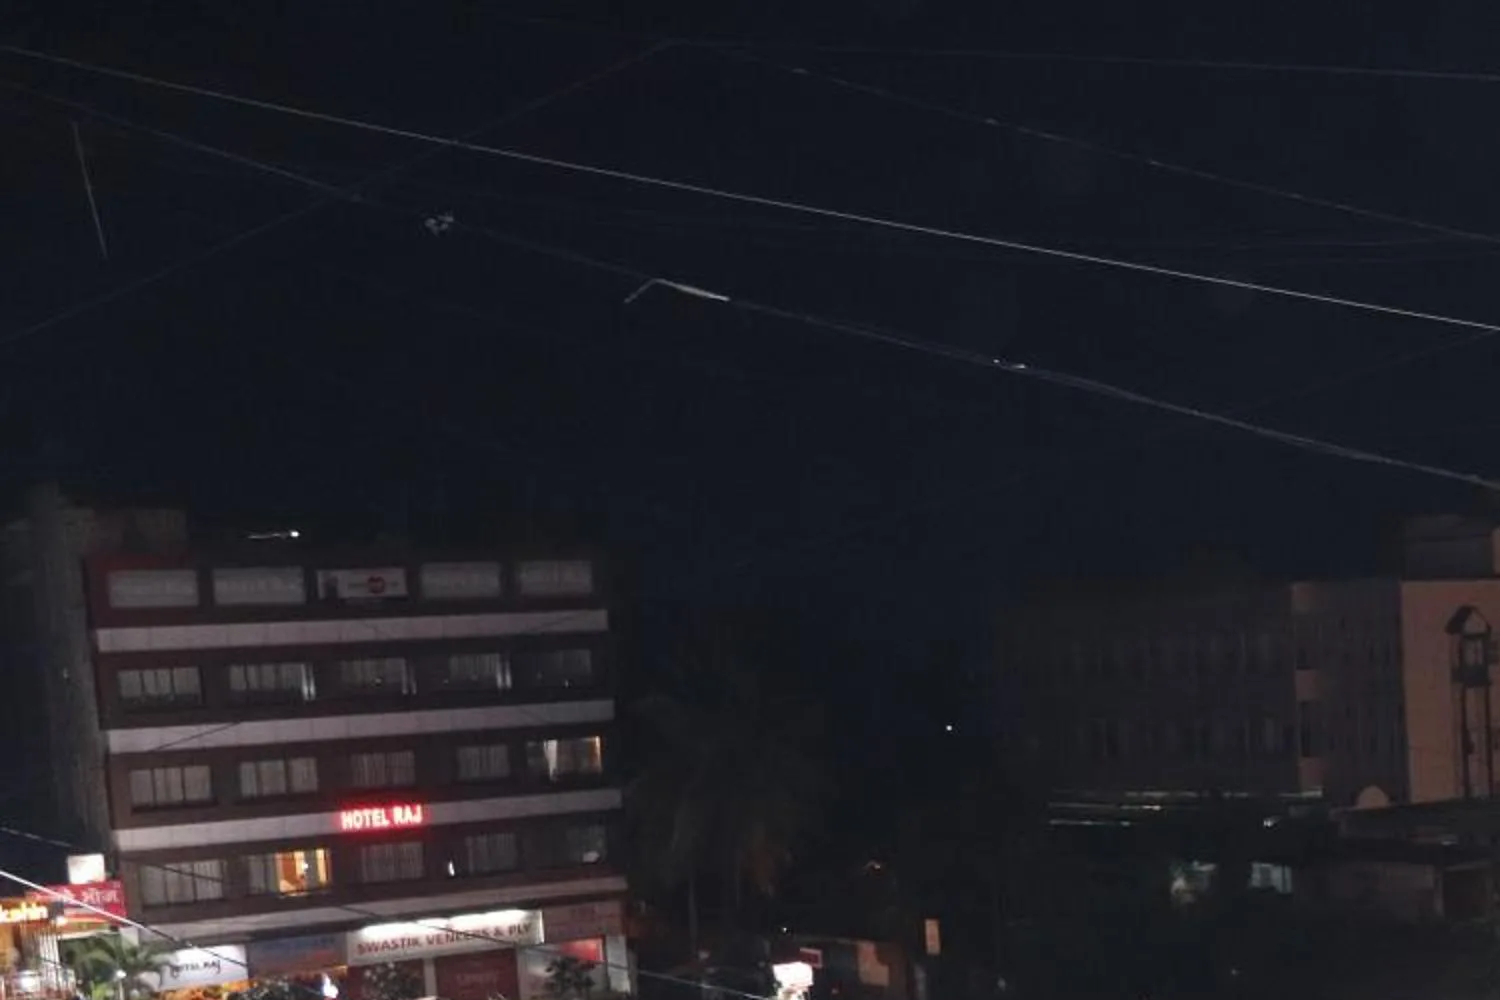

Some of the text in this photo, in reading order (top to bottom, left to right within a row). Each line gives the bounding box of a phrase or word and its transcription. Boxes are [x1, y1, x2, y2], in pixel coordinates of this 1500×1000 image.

[341, 804, 423, 829] HOTEL RAJ
[357, 937, 421, 956] SWASTIK
